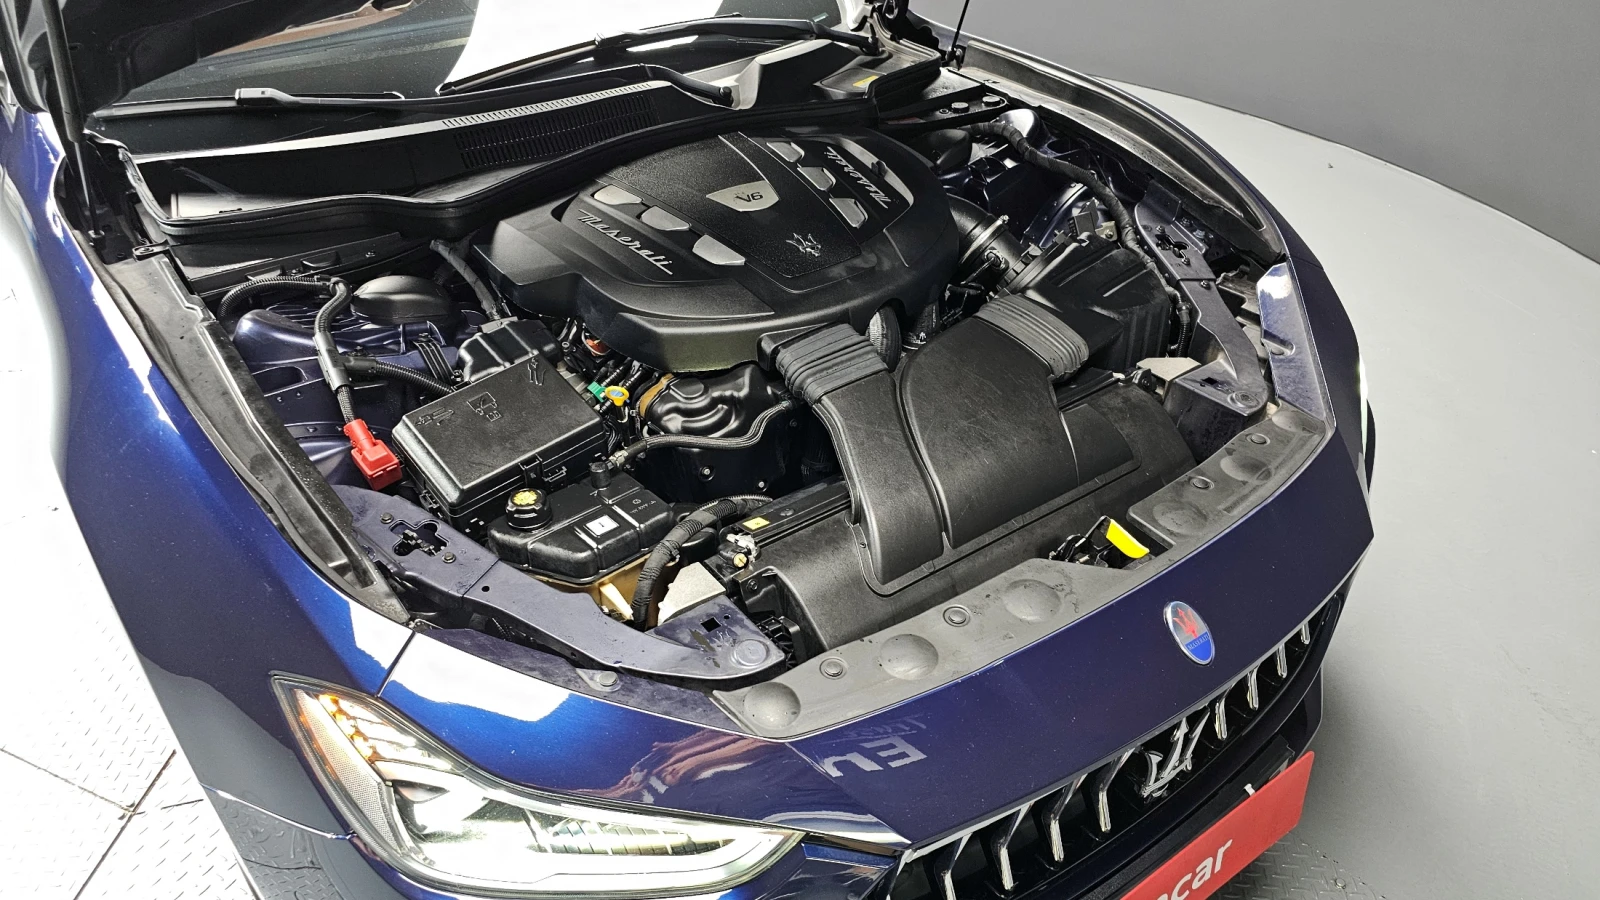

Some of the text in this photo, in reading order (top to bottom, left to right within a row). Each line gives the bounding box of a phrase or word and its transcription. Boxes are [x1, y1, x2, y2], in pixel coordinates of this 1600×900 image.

[734, 191, 764, 203] V6
[824, 145, 891, 209] Maserati
[577, 208, 673, 275] Maserati
[1156, 838, 1233, 900] car
